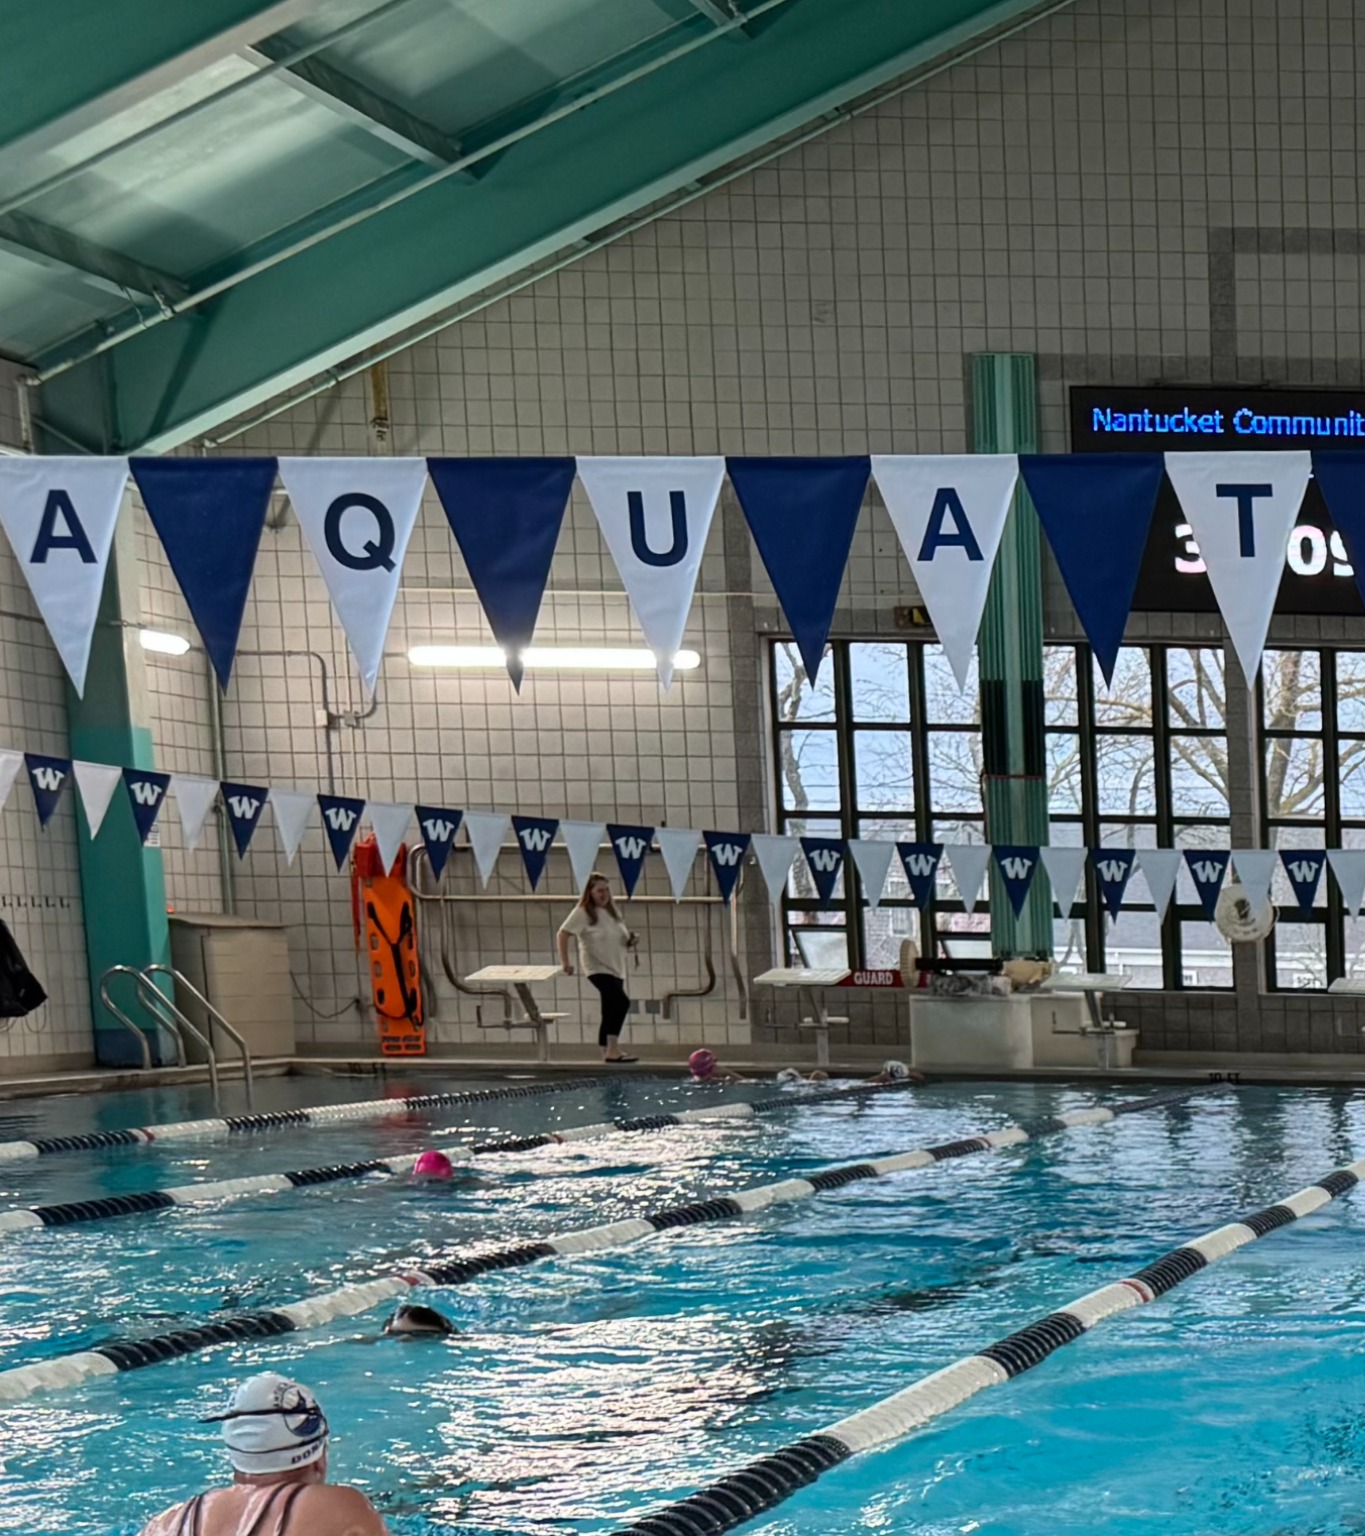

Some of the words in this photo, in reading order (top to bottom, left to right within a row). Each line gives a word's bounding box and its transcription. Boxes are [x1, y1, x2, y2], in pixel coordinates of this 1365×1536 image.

[1093, 407, 1224, 432] Nantucket
[33, 768, 64, 790] W
[131, 783, 161, 805] W
[229, 797, 259, 818] W
[326, 809, 356, 830] W
[424, 820, 453, 841] W
[521, 829, 550, 850] W
[616, 838, 645, 858] W
[713, 845, 741, 865] W
[811, 850, 839, 870] W
[907, 855, 935, 875] W
[1002, 858, 1031, 878] W
[1098, 861, 1126, 881] W
[1193, 862, 1222, 882] W
[1289, 862, 1318, 881] W
[853, 971, 893, 985] GUARD
